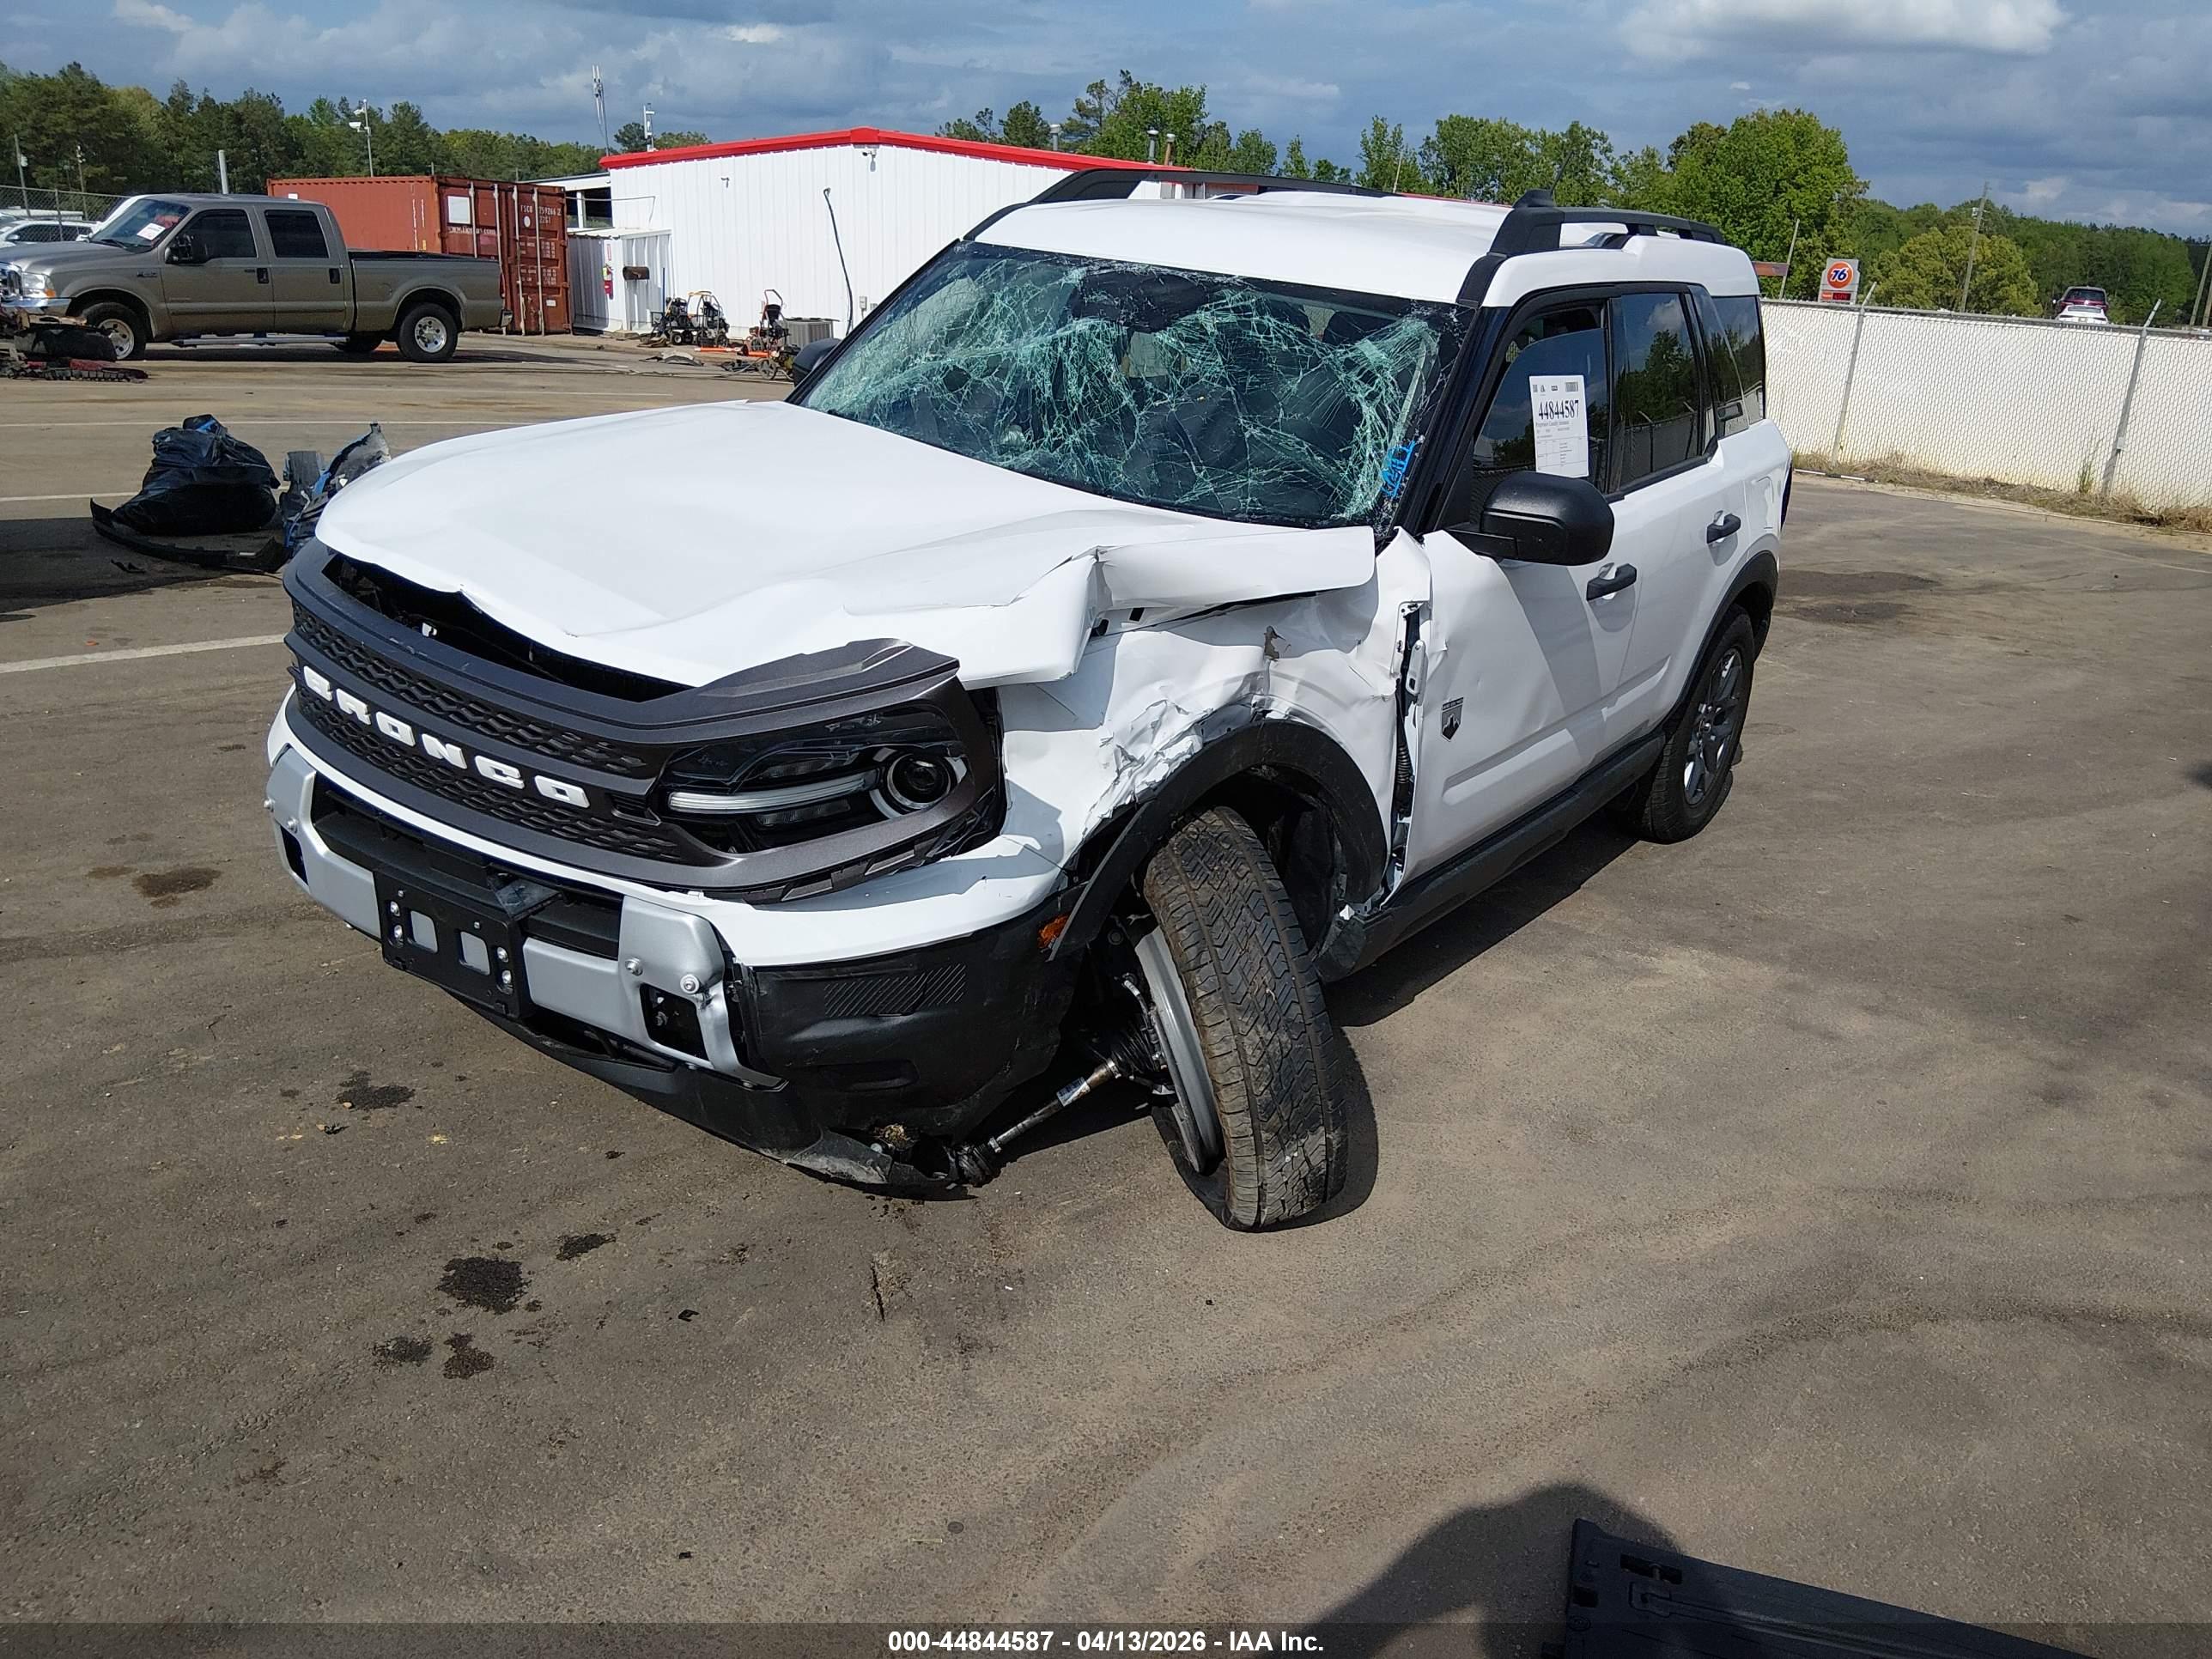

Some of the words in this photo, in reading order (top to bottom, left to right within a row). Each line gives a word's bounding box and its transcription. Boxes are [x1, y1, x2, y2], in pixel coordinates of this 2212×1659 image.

[1830, 267, 1850, 282] 76
[1538, 399, 1579, 420] 44844587
[303, 665, 590, 808] BRONCO
